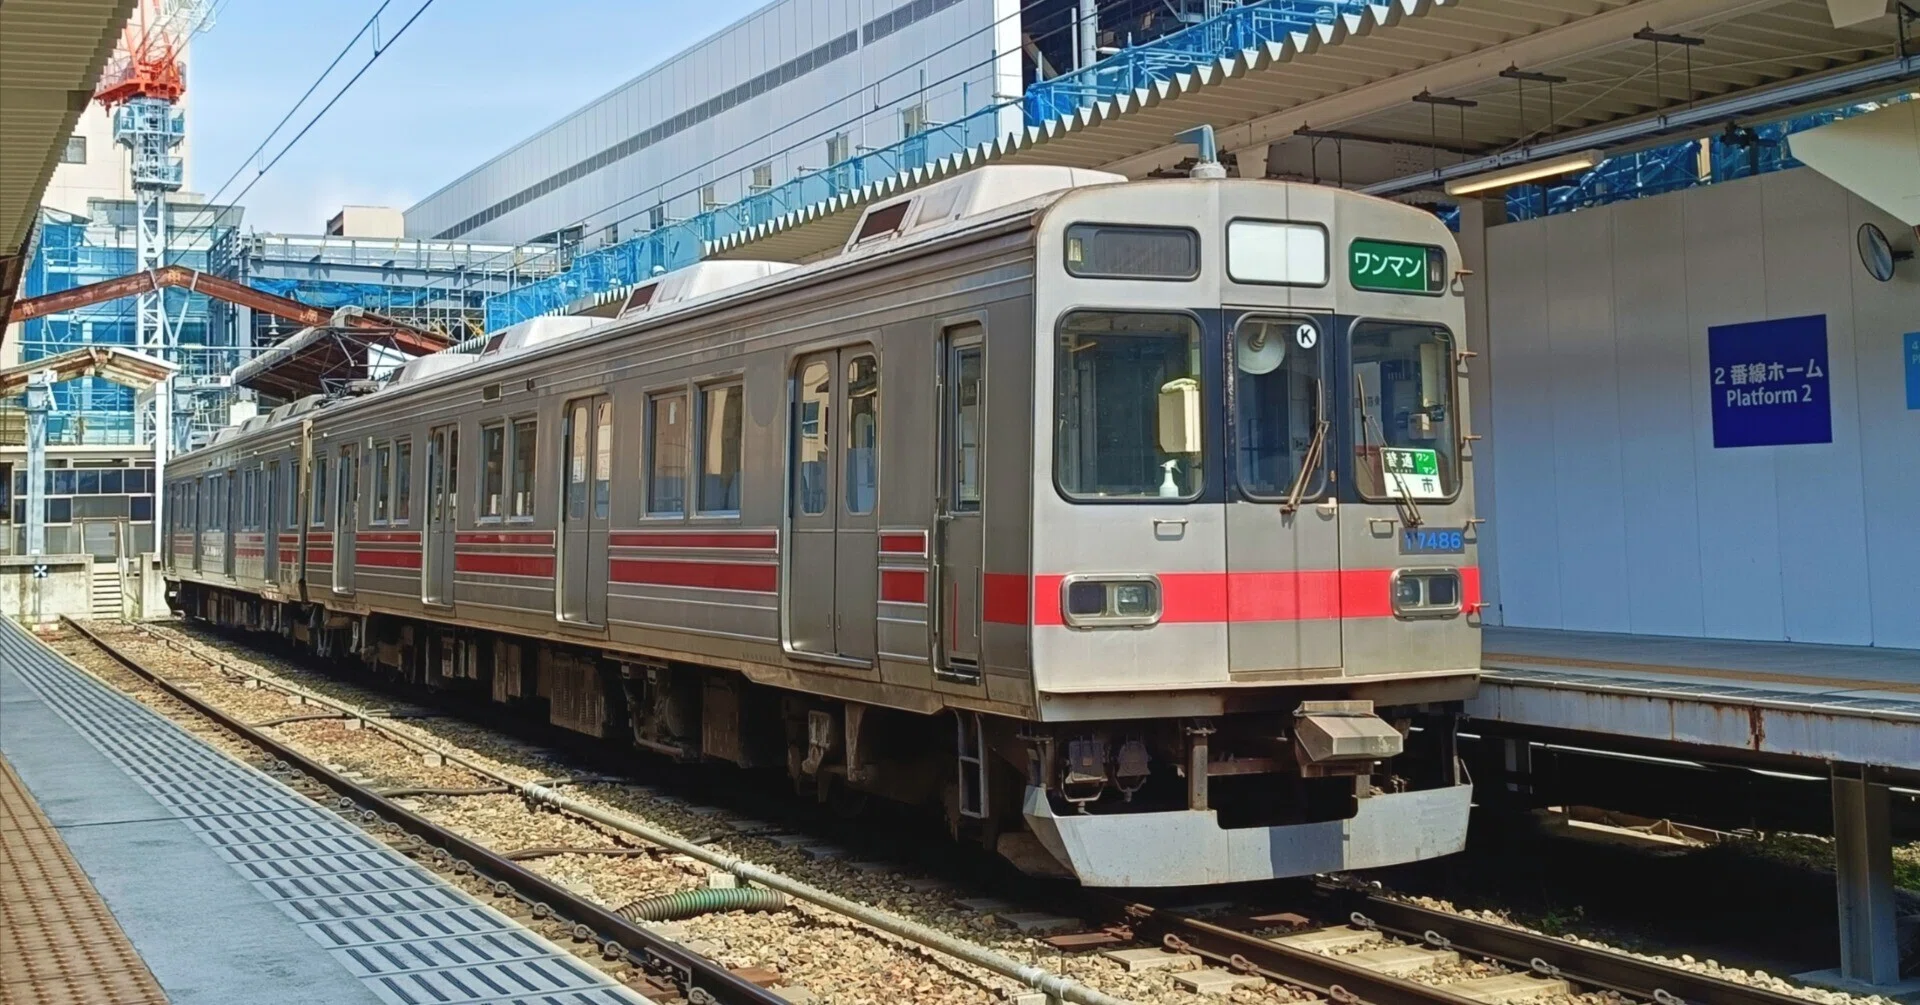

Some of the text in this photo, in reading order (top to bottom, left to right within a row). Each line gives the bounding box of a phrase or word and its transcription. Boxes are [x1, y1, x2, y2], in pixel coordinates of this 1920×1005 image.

[1355, 252, 1421, 278] ワンマン
[1300, 328, 1312, 344] K
[1727, 384, 1813, 407] Platform 2
[1404, 532, 1461, 550] 17486
